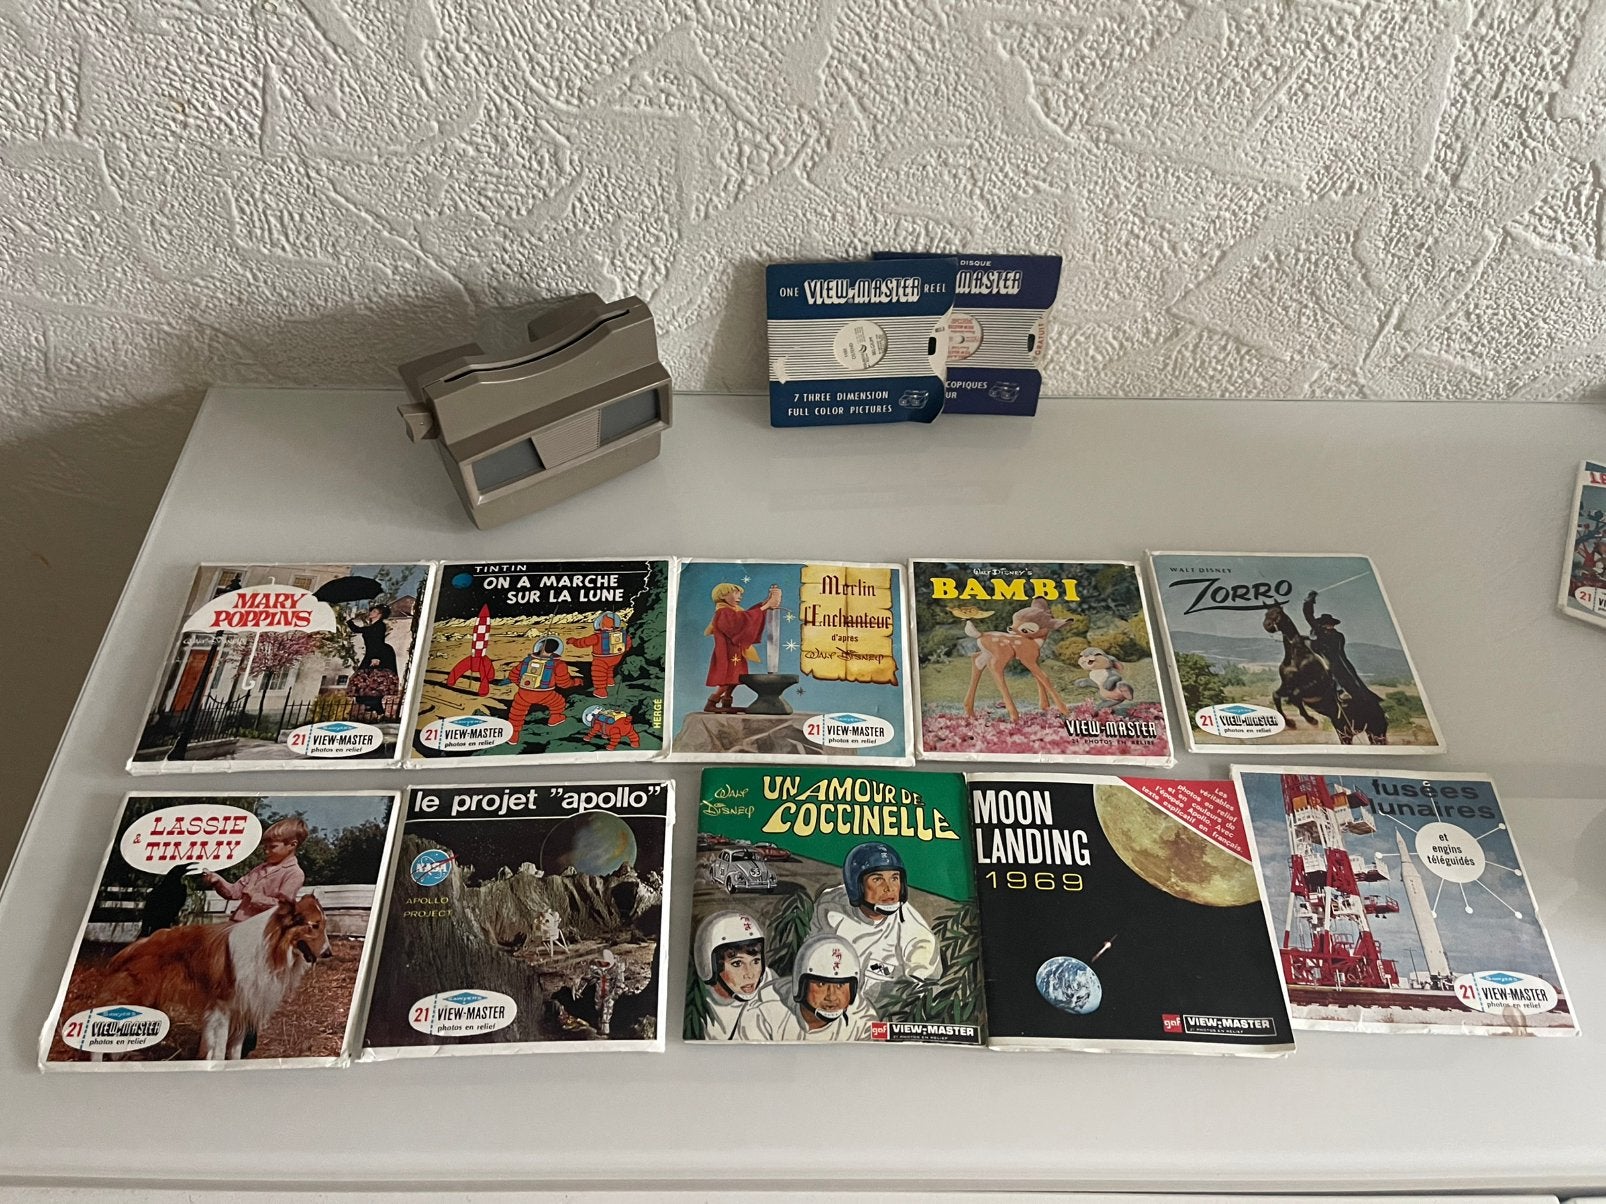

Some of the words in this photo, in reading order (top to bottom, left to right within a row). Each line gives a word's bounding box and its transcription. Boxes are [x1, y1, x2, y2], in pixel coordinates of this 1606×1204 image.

[779, 287, 799, 297] ONE
[804, 277, 921, 304] VIEW-MASTER
[924, 283, 946, 293] REEL
[793, 393, 799, 402] 7
[803, 393, 831, 402] THREE
[837, 391, 888, 401] DIMENSION
[788, 407, 809, 416] FULL
[815, 407, 844, 416] COLOR
[850, 404, 892, 414] PICTURES
[475, 564, 527, 573] TINTIN
[483, 576, 510, 590] ON
[517, 576, 531, 588] A
[540, 575, 619, 588] MARCHE
[820, 575, 876, 597] Merlin
[930, 577, 1080, 601] BAMBI
[232, 592, 308, 609] MARY
[506, 590, 541, 604] SUR
[549, 589, 572, 603] LA
[579, 589, 624, 602] LUNE
[1168, 578, 1293, 615] ZORRO
[1579, 590, 1591, 602] 21
[209, 610, 313, 628] POPPINS
[1065, 719, 1157, 738] VIEW-MASTER
[1199, 715, 1214, 727] 21
[425, 729, 438, 741] 21
[444, 727, 504, 740] VIEW-MASTER
[807, 723, 820, 736] 21
[827, 725, 885, 737] VIEW-MASTER
[291, 733, 306, 746] 21
[313, 734, 374, 746] VIEW-MASTER
[763, 775, 801, 800] UN
[795, 777, 897, 804] AMOUR
[901, 788, 925, 806] DE
[1214, 787, 1228, 799] Les
[414, 791, 440, 812] le
[451, 789, 538, 816] projet
[972, 789, 1053, 825] MOON
[1177, 784, 1202, 802] photos
[1204, 801, 1214, 810] en
[1216, 809, 1238, 823] relief
[1199, 788, 1235, 812] véritables
[1155, 785, 1185, 808] l'épopée
[1187, 807, 1212, 826] Apollo.
[1215, 824, 1235, 838] Avec
[1178, 794, 1188, 802] en
[1191, 802, 1222, 823] couleurs
[1225, 822, 1236, 831] de
[1369, 798, 1496, 819] lunaires
[149, 815, 248, 836] LASSIE
[761, 801, 961, 841] COCCINELLE
[1141, 785, 1160, 800] texte
[1162, 801, 1197, 823] explicatif
[1198, 824, 1208, 832] en
[1211, 831, 1243, 853] français.
[1438, 832, 1449, 842] et
[133, 833, 142, 844] &
[145, 840, 241, 861] TIMMY
[975, 828, 1091, 866] LANDING
[1432, 844, 1463, 856] engins
[1427, 855, 1476, 867] téléguidés
[985, 871, 1083, 891] 1969
[405, 896, 449, 905] APOLLO
[403, 909, 453, 918] PROJECT
[1459, 984, 1476, 1000] 21
[1481, 987, 1549, 1002] VIEW-MASTER
[1486, 1001, 1511, 1009] photos
[413, 1007, 430, 1022] 21
[437, 1005, 505, 1021] VIEW-MASTER
[66, 1022, 83, 1037] 21
[437, 1024, 462, 1033] photos
[1164, 1017, 1181, 1029] gaf
[1187, 1016, 1270, 1029] VIEW-MASTER
[872, 1025, 887, 1036] gaf
[892, 1024, 974, 1037] VIEW-MASTER
[89, 1038, 113, 1046] photos
